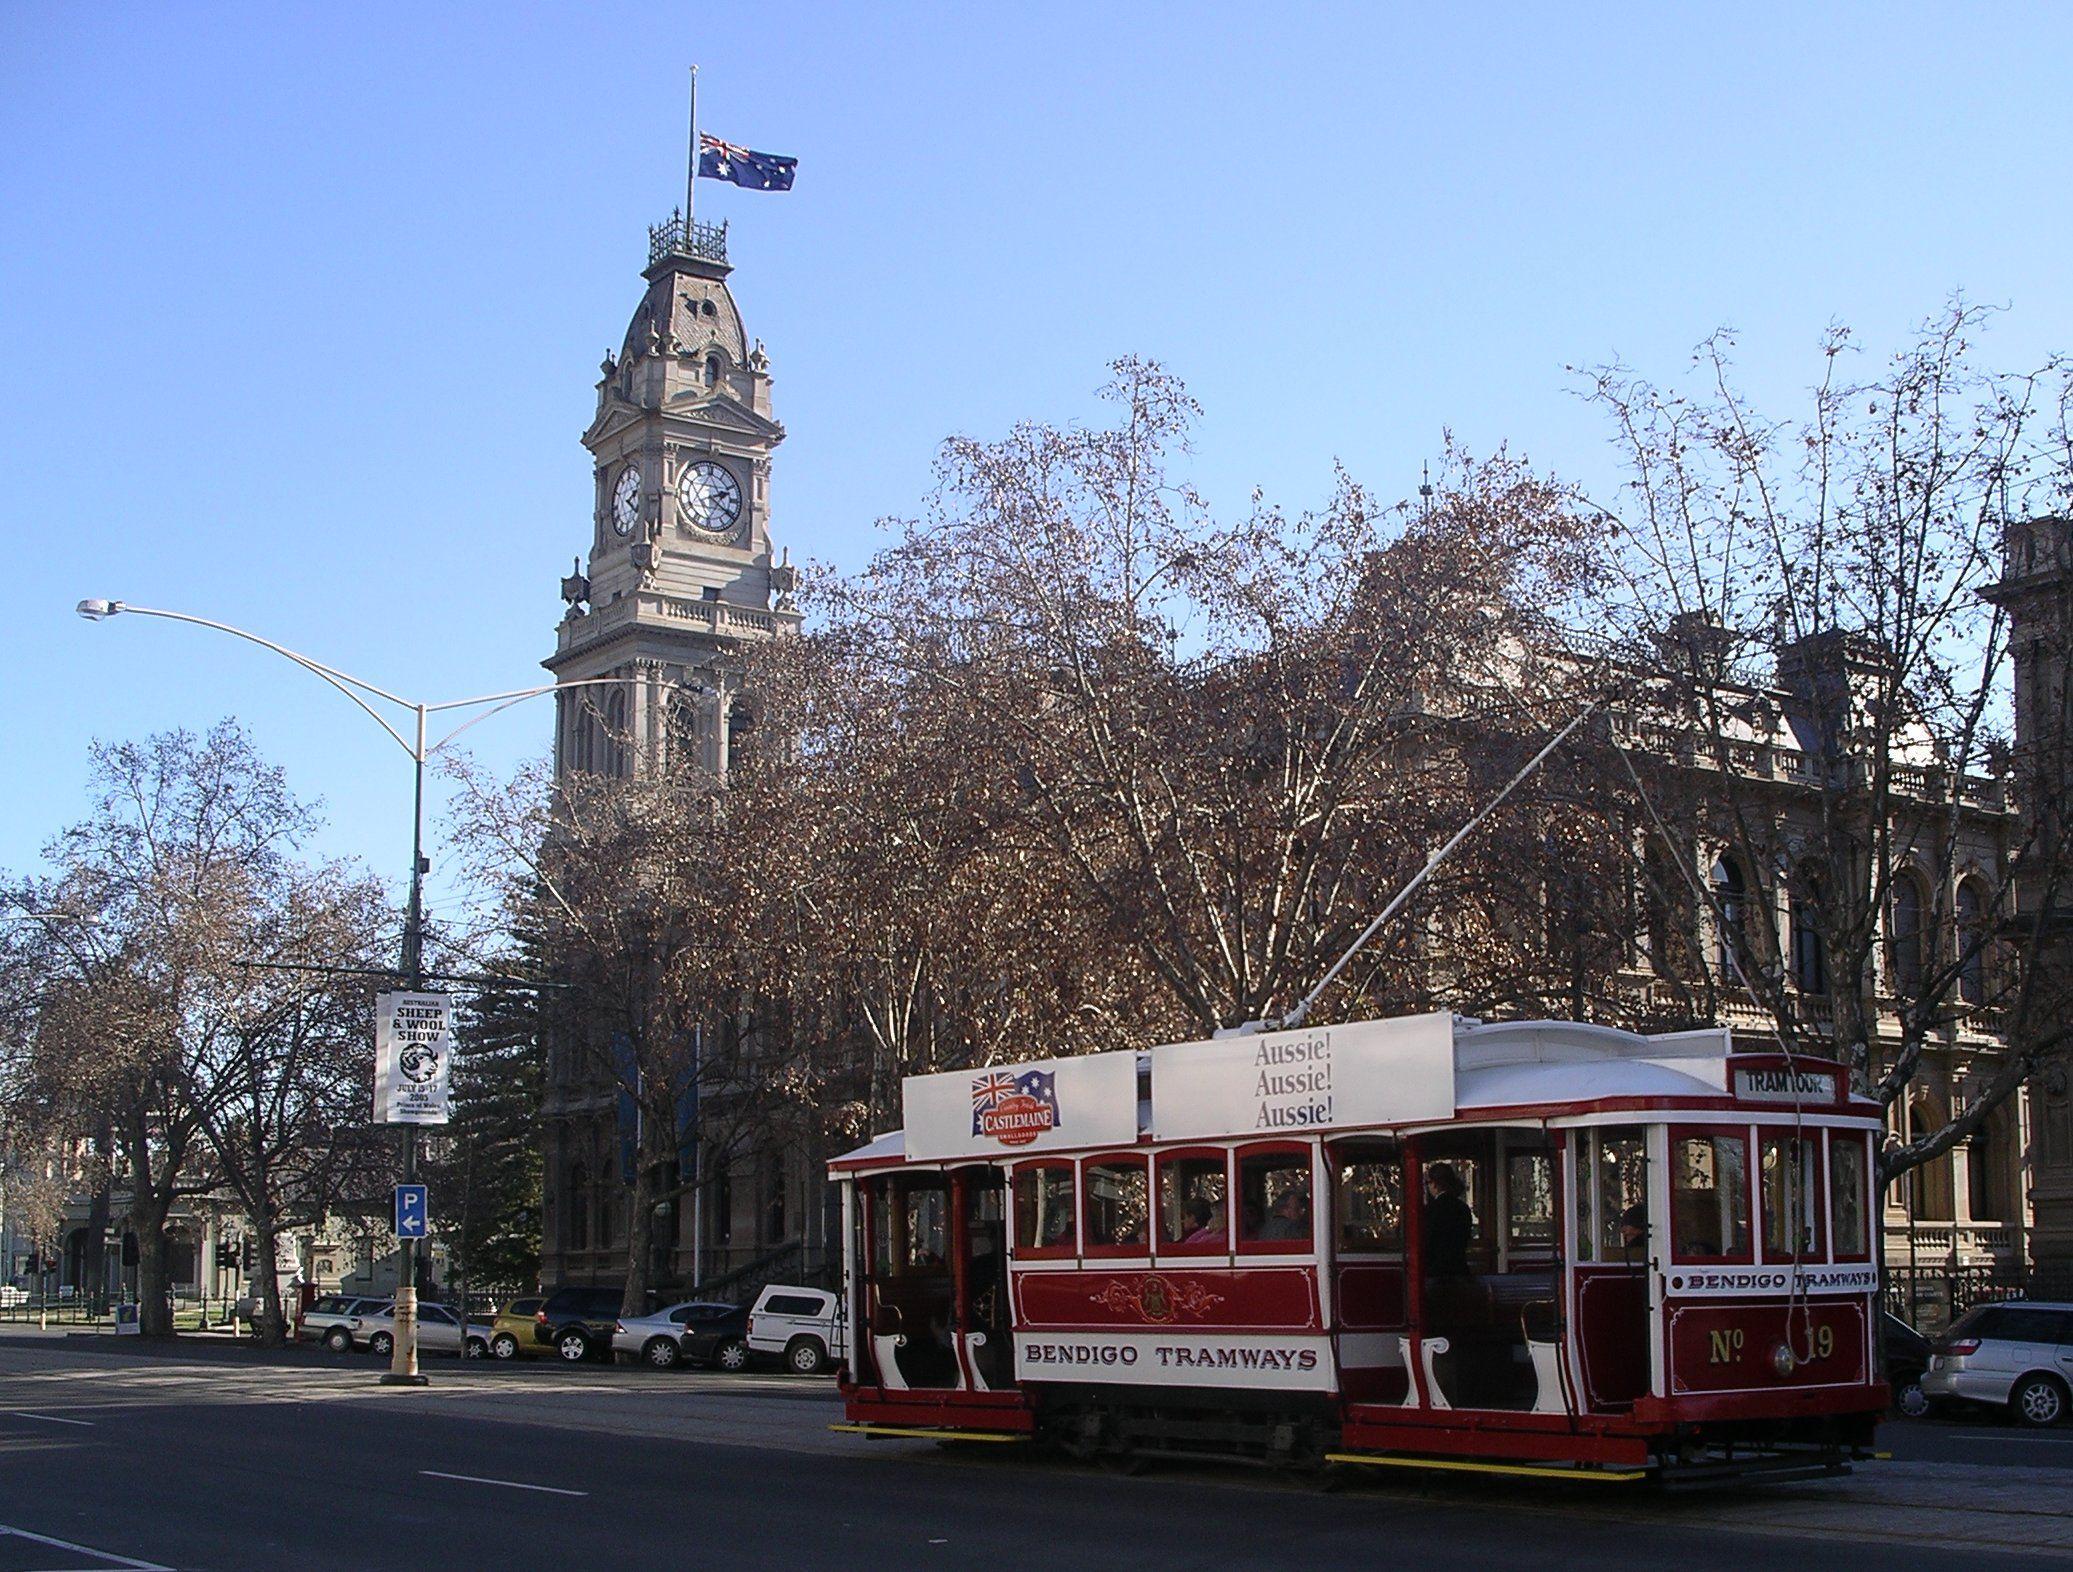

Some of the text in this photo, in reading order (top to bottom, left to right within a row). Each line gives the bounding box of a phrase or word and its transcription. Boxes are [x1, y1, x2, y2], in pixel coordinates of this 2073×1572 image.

[397, 1007, 442, 1019] SHEEP
[392, 1019, 446, 1031] & WOOL
[397, 1031, 440, 1042] SHOW
[1255, 1032, 1331, 1067] Aussie!
[397, 1084, 417, 1093] JULY
[1255, 1063, 1331, 1097] Aussie!
[985, 1109, 1052, 1132] CASTLEMAINE
[1256, 1095, 1332, 1128] Aussie!
[404, 1193, 418, 1210] P
[1689, 1272, 1871, 1290] BENDIGO TRAMWAYS
[1025, 1344, 1318, 1371] BENDIGO TRAMWAYS
